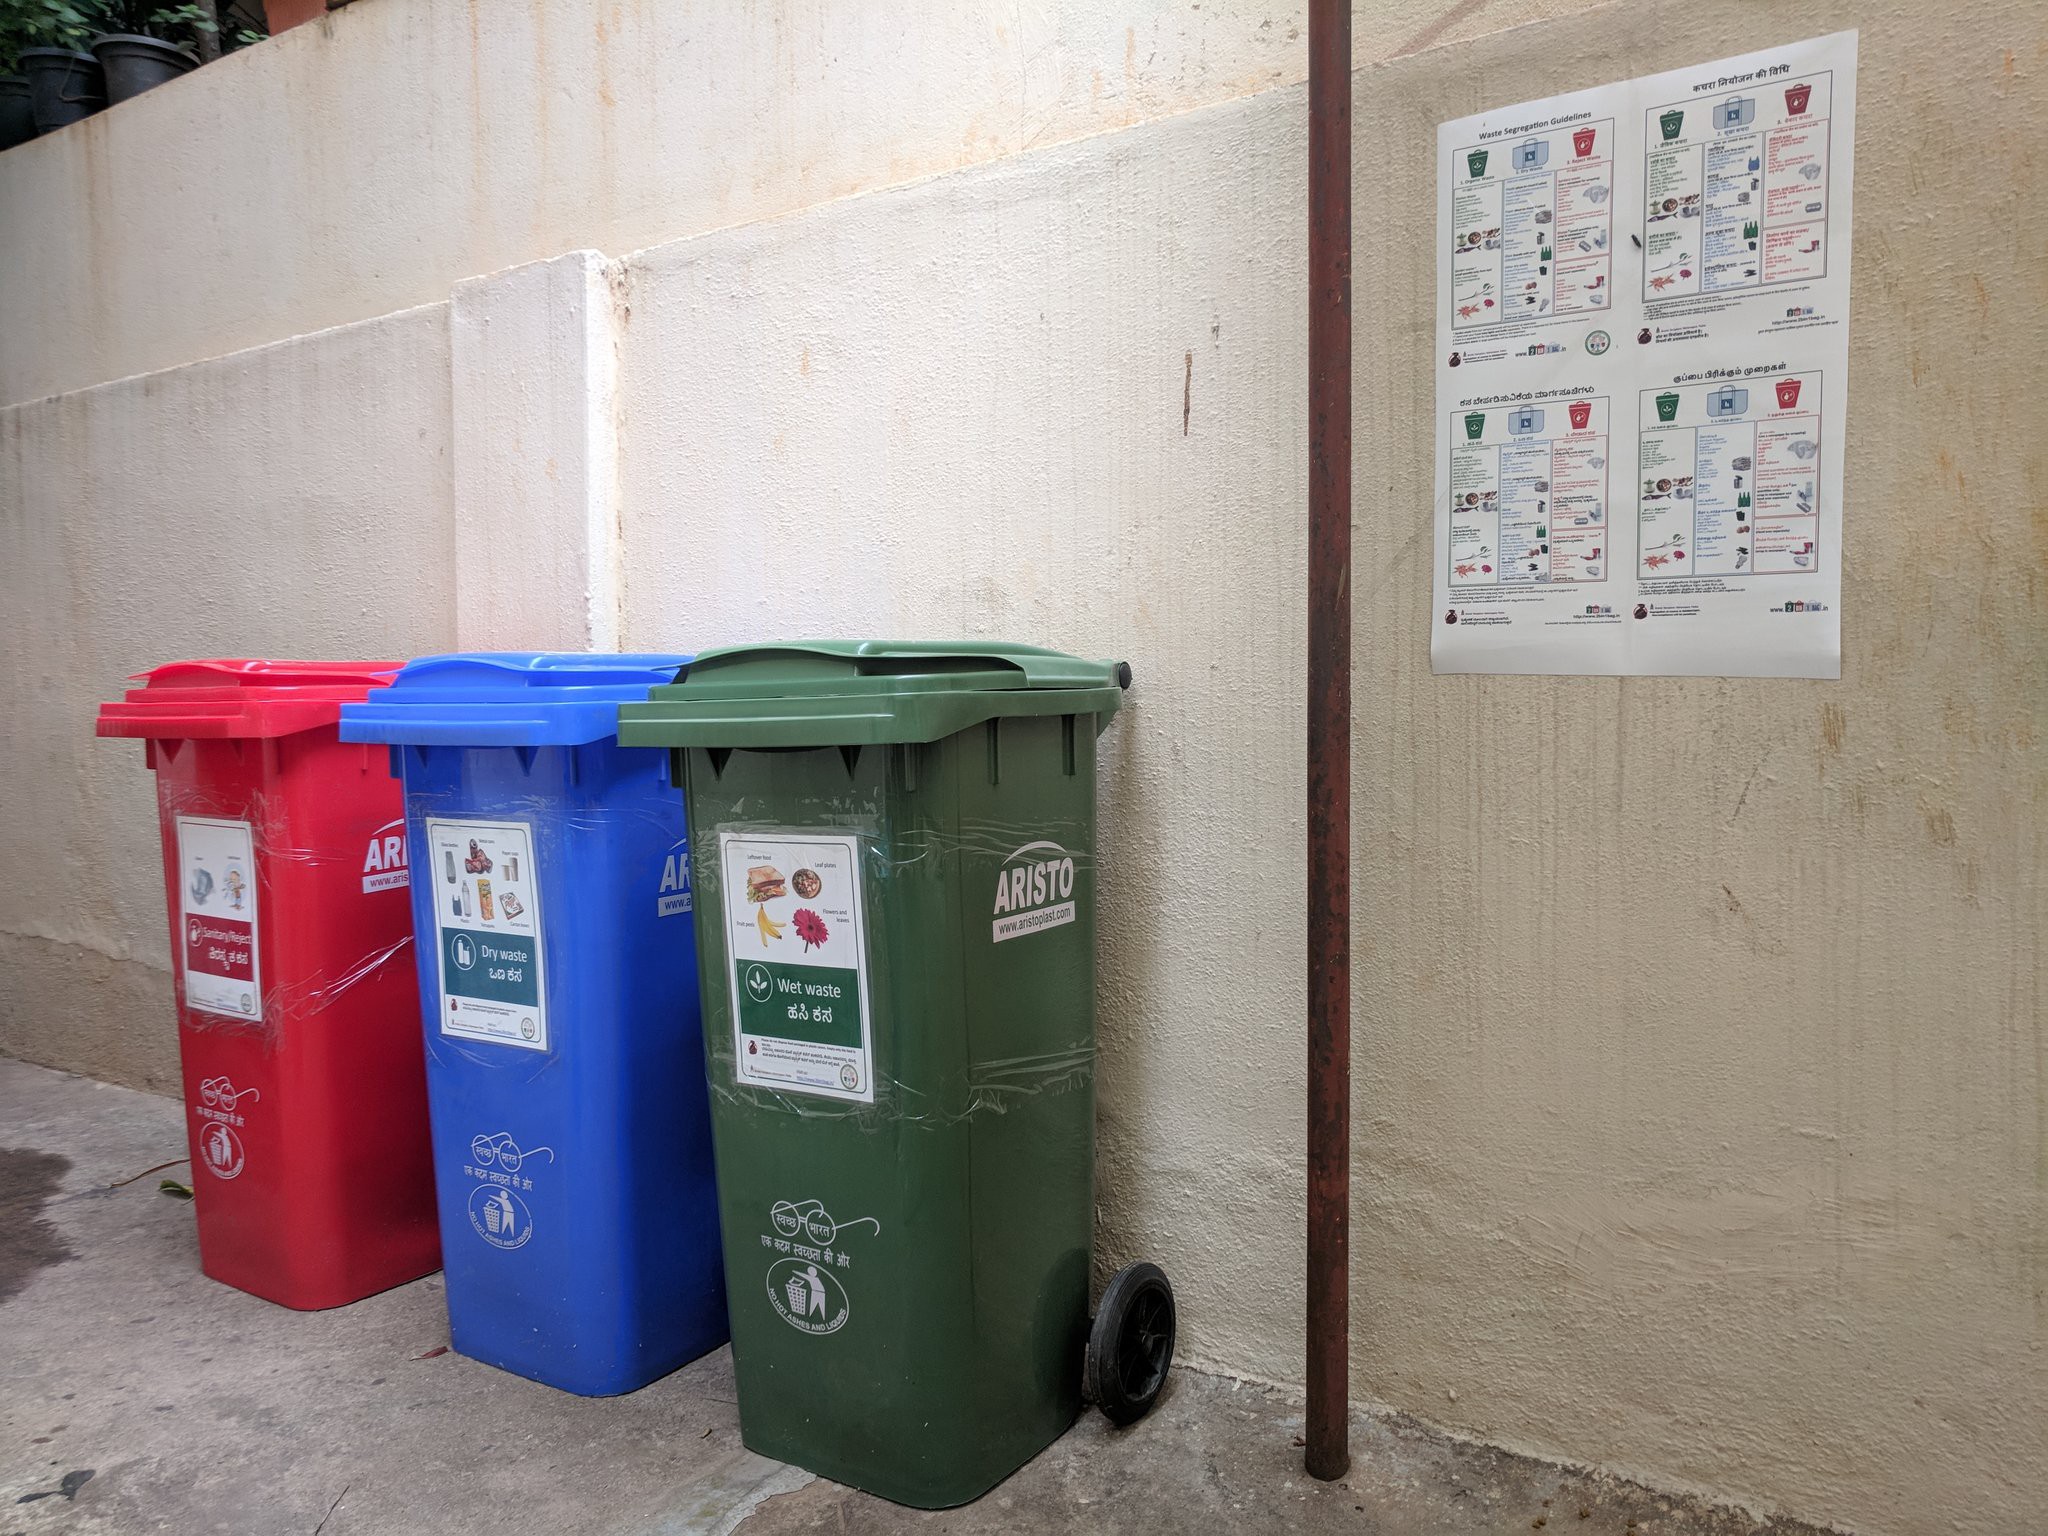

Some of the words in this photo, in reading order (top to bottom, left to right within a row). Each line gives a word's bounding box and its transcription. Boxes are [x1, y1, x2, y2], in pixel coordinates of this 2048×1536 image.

[1693, 81, 1716, 92] कचरा
[1718, 73, 1752, 87] नियोजन
[1755, 69, 1767, 80] की
[1769, 64, 1790, 75] विधि
[1479, 129, 1502, 140] Waste
[1504, 119, 1548, 135] Segregation
[1550, 111, 1591, 126] Guidelines
[1673, 373, 1703, 383] குப்பை
[1744, 362, 1786, 375] முறைகள்
[994, 857, 1073, 914] ARISTO
[999, 907, 1070, 934] www.aristoplast.com
[203, 926, 252, 945] Sanitary/Reject
[482, 945, 498, 961] Dry
[500, 949, 527, 962] waste
[489, 968, 505, 980] ಒಣ
[508, 967, 522, 982] ಕಸ
[777, 978, 801, 994] Wet
[805, 983, 841, 998] waste
[787, 1003, 809, 1021] ಹಸಿ
[813, 1006, 833, 1023] ಕಸ
[501, 1152, 517, 1164] भारत
[776, 1214, 796, 1228] स्वच्छ
[809, 1222, 830, 1238] भारत
[761, 1235, 772, 1247] एक
[774, 1238, 791, 1253] कदम
[793, 1243, 820, 1261] स्वच्छता
[824, 1248, 833, 1264] की
[837, 1251, 850, 1269] ओर
[769, 1288, 777, 1300] NO
[775, 1300, 787, 1315] HOT
[788, 1313, 810, 1330] ASHES
[827, 1308, 846, 1330] LIQUIDS
